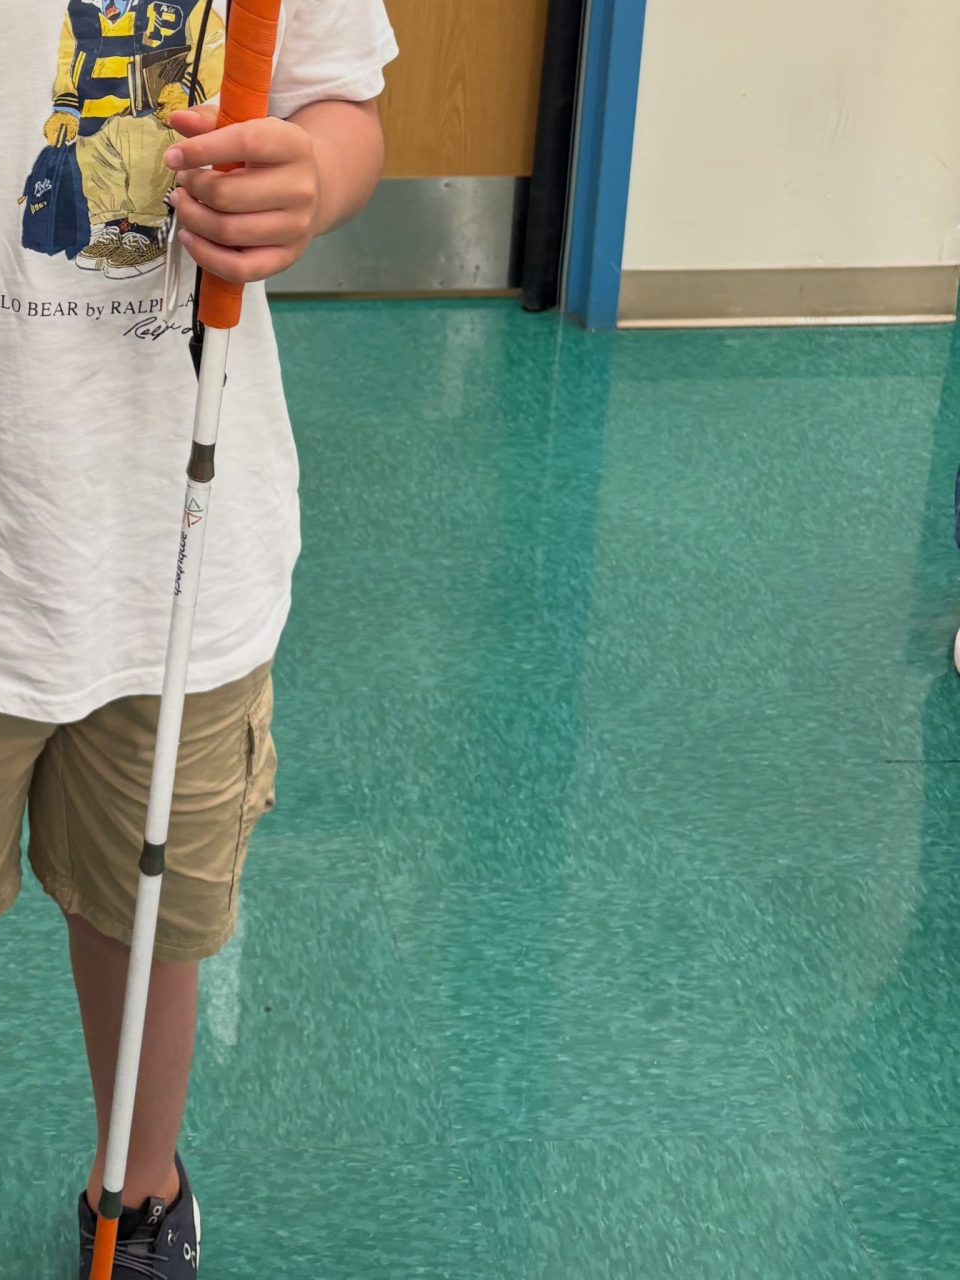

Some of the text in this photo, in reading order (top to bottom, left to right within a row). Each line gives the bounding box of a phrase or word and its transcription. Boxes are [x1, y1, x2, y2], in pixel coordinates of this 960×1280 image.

[27, 301, 79, 317] BEAR
[85, 302, 105, 320] by
[109, 297, 164, 315] RALP
[173, 531, 188, 596] ambutech
